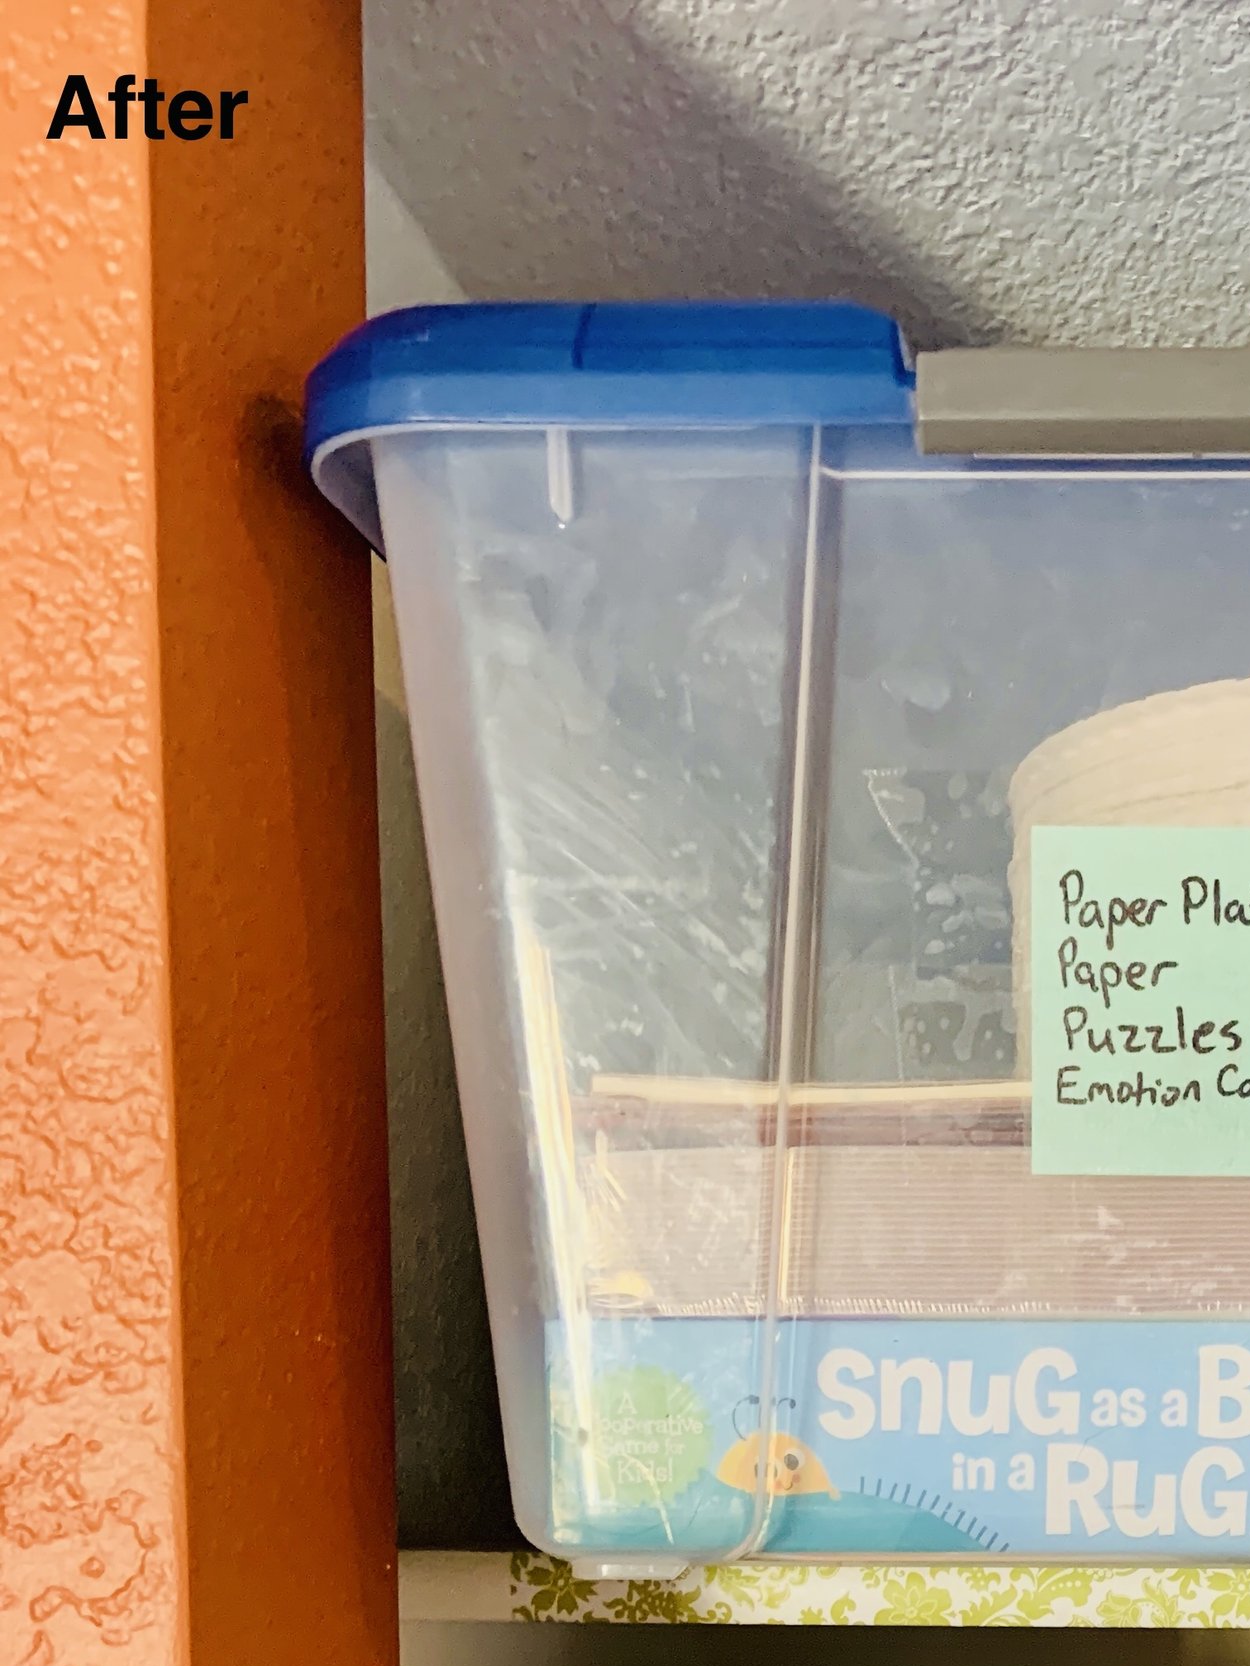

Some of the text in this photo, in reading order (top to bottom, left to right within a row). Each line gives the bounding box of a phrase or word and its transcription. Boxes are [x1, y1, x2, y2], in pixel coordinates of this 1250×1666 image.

[1058, 869, 1167, 950] Paper
[1058, 936, 1178, 1008] Paper
[1063, 1005, 1243, 1055] Puzzles
[1056, 1065, 1200, 1107] Emotion
[594, 1414, 704, 1436] ooperative
[1090, 1387, 1147, 1428] as
[1160, 1387, 1187, 1428] a
[952, 1452, 995, 1491] in
[1008, 1454, 1035, 1492] a
